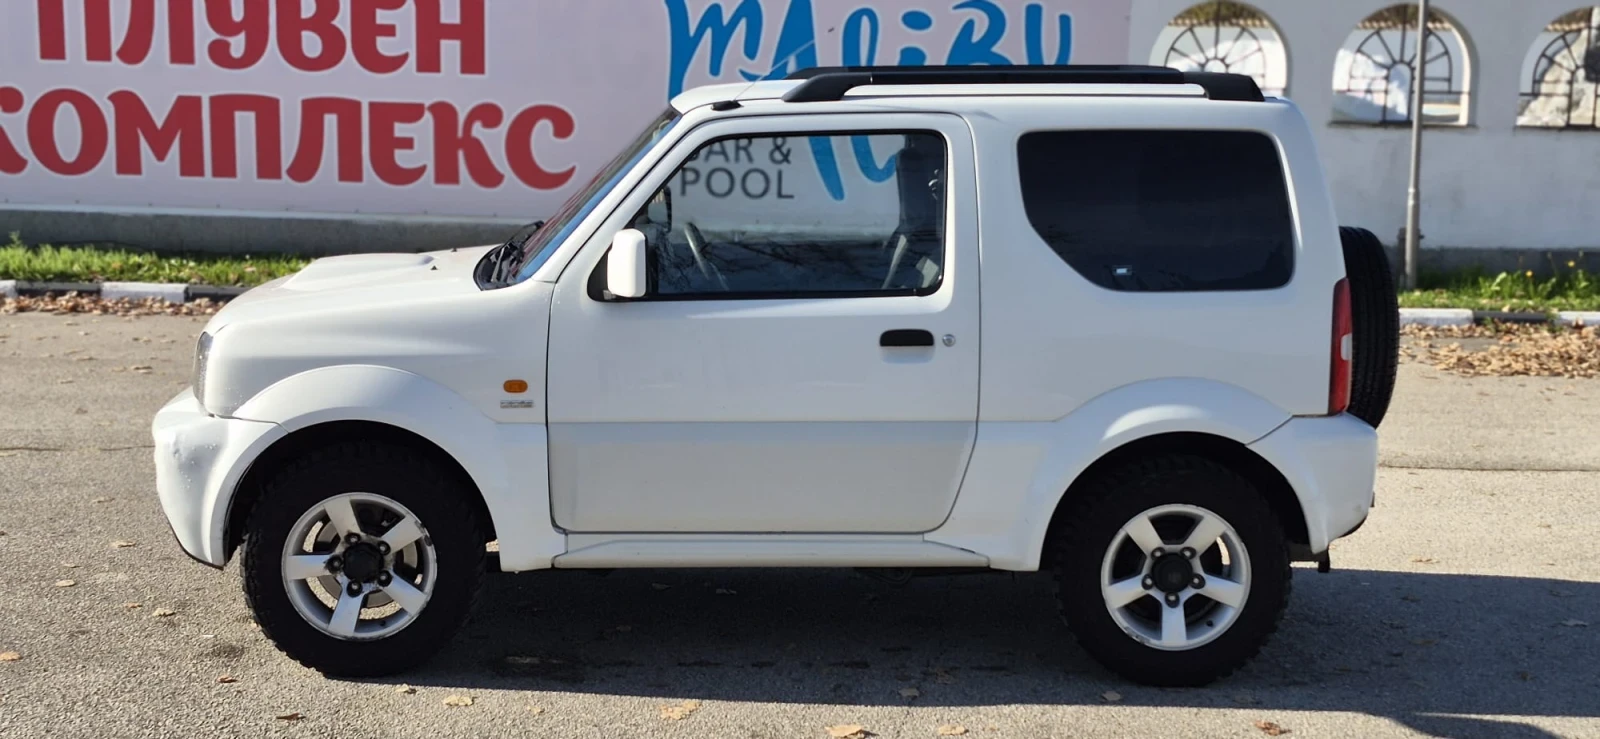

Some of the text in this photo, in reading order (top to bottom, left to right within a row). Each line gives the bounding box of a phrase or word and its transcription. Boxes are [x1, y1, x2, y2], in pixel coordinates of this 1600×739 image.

[687, 136, 792, 165] AR &
[680, 167, 795, 199] POOL
